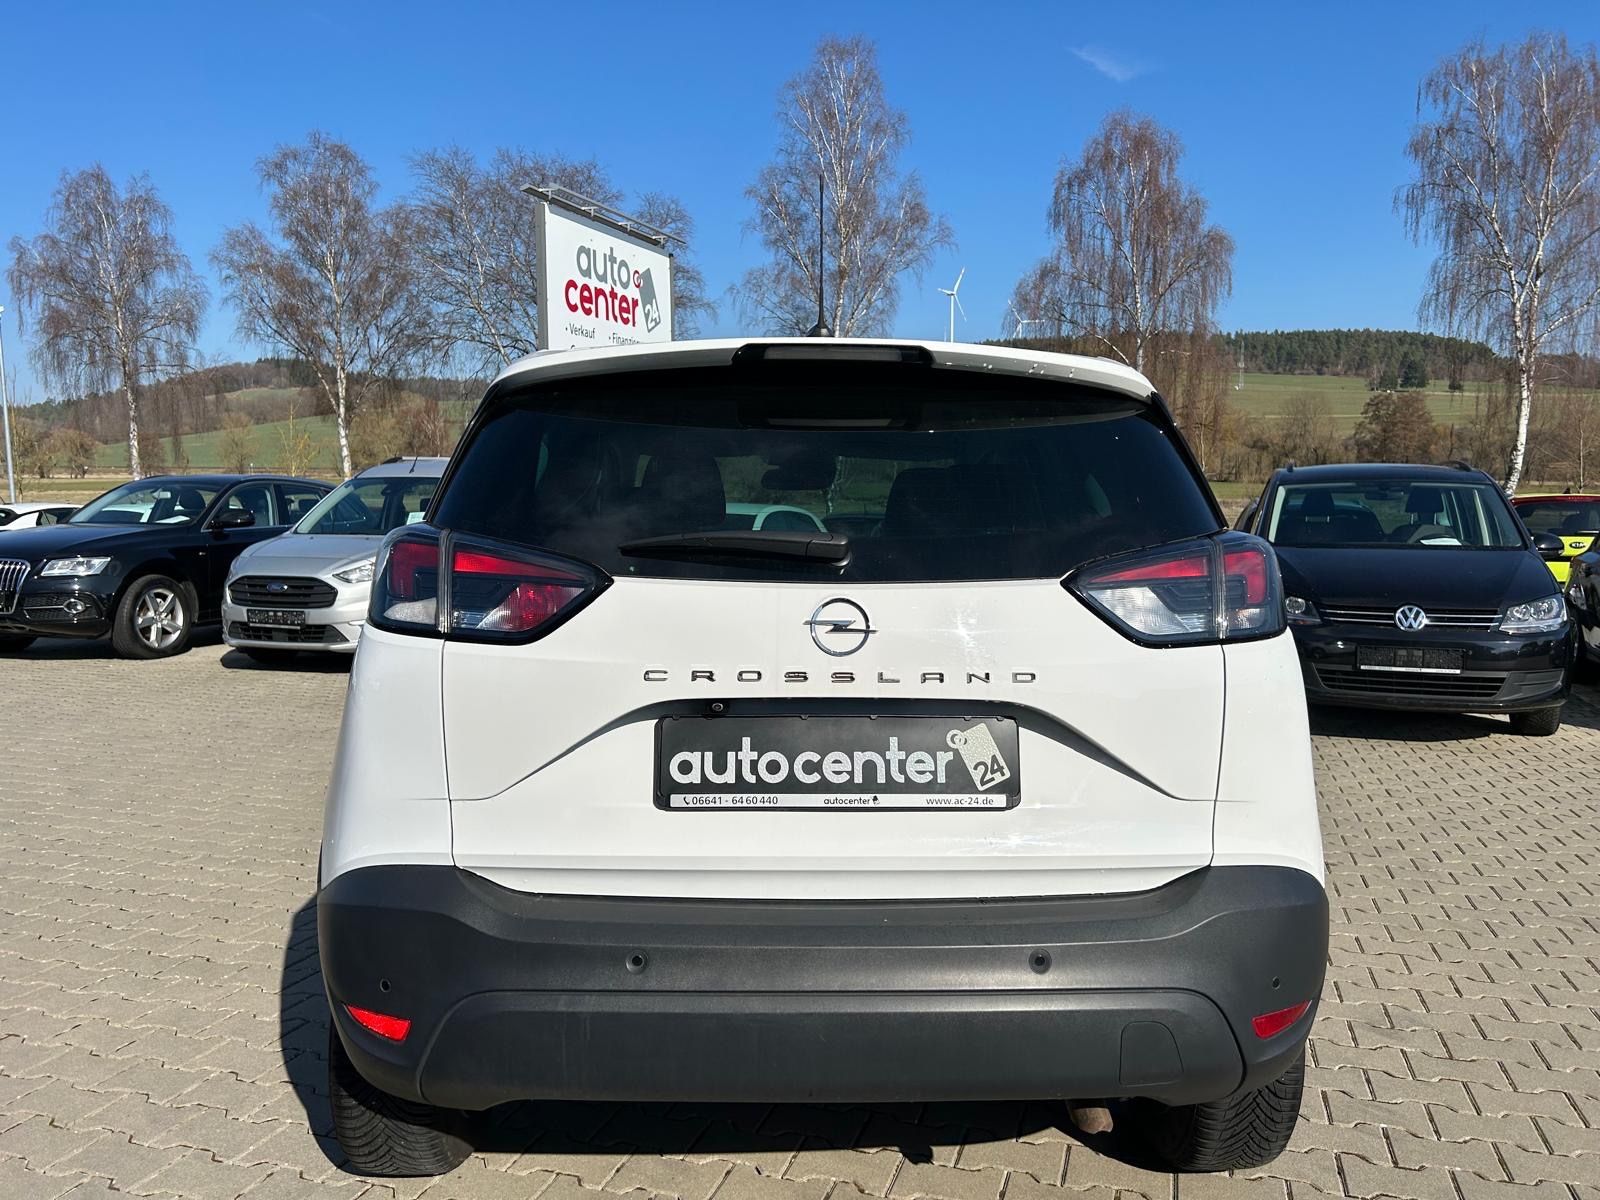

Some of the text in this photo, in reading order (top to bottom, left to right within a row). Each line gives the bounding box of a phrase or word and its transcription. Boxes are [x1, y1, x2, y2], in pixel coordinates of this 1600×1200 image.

[576, 245, 631, 289] auto
[565, 279, 639, 327] center
[645, 299, 659, 326] 24
[569, 323, 595, 339] Verkauf
[643, 669, 1037, 684] CROSSLAND
[669, 736, 953, 784] autocenter
[973, 754, 1005, 786] 24
[823, 796, 870, 805] autocenter
[926, 796, 994, 805] www.ac-24.de
